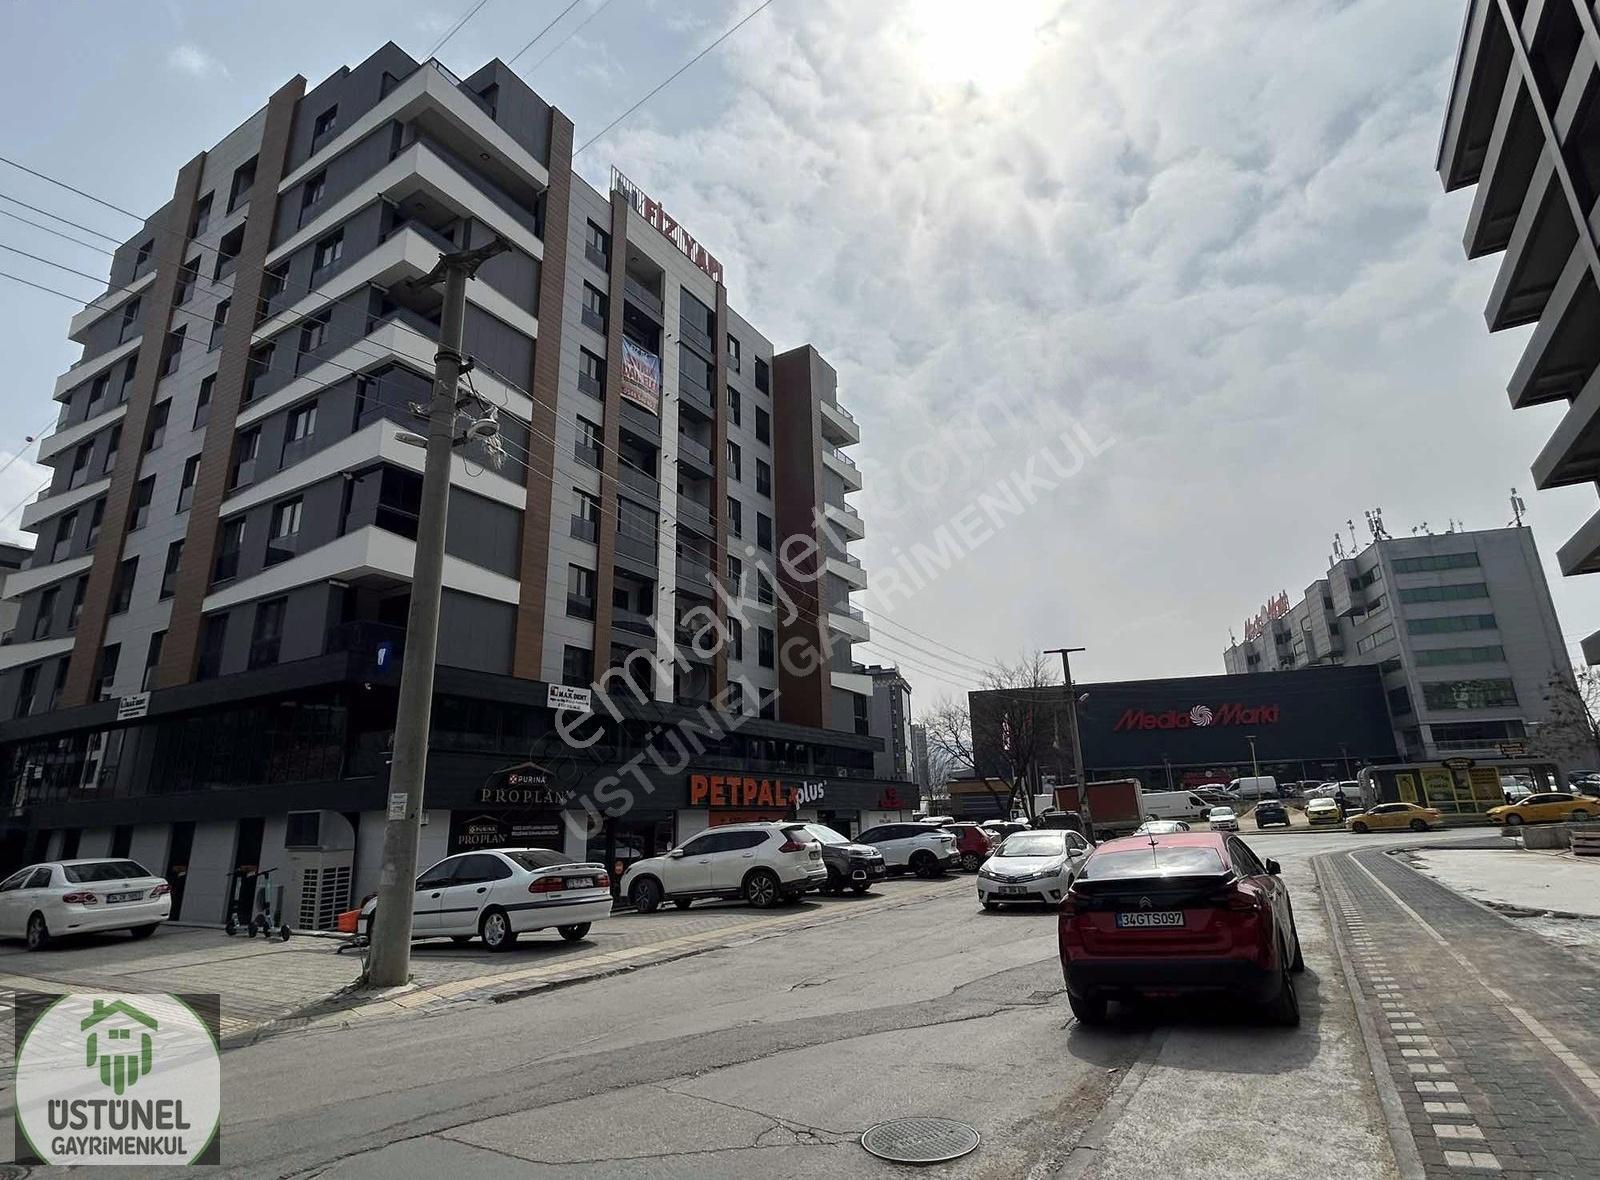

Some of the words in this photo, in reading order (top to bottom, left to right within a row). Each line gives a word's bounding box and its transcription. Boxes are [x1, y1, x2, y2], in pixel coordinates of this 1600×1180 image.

[1113, 708, 1192, 732] Media
[517, 775, 546, 784] PURINA
[690, 774, 787, 808] PETPAL
[796, 779, 825, 811] plus
